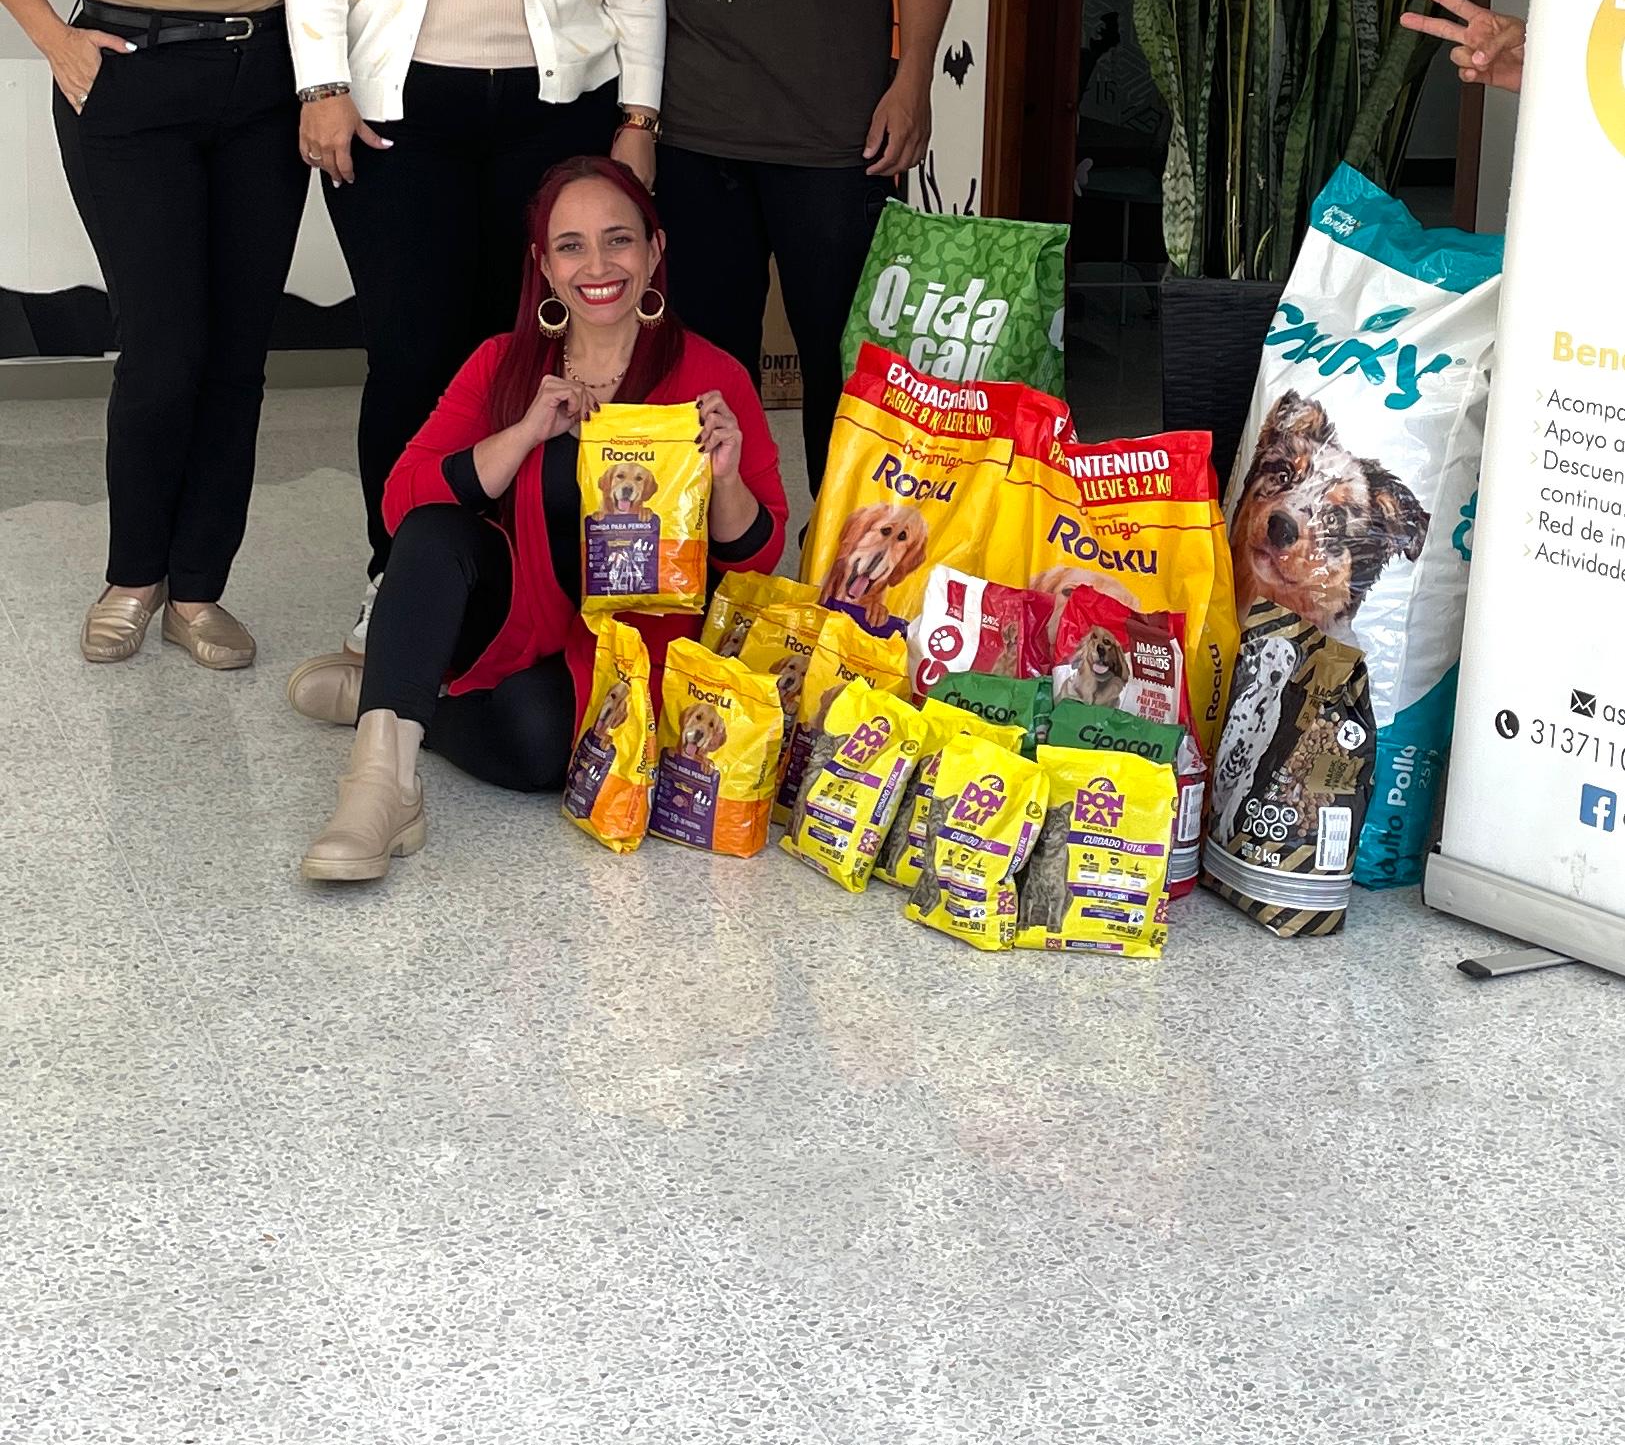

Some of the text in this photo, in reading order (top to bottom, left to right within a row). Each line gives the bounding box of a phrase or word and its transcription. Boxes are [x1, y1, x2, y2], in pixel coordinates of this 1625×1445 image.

[908, 336, 994, 382] can
[1553, 330, 1625, 371] Ben
[883, 386, 920, 419] PAGUE
[1544, 420, 1607, 450] Apoyo
[1066, 449, 1169, 479] ONTENIDO
[1543, 450, 1625, 484] Descuen
[1082, 472, 1173, 502] LLEVE 8.2 Kg
[1538, 511, 1573, 537] Red
[1581, 520, 1604, 544] de
[1136, 641, 1168, 655] MAGIC
[1137, 656, 1170, 671] FRIENDS
[1387, 745, 1417, 807] Pollo
[962, 781, 1007, 812] DON
[1076, 789, 1125, 812] DON
[952, 799, 995, 826] KAT
[1074, 806, 1124, 828] KAT
[1083, 834, 1148, 854] CUIDADO TOTAL
[1254, 845, 1281, 867] 2 kg
